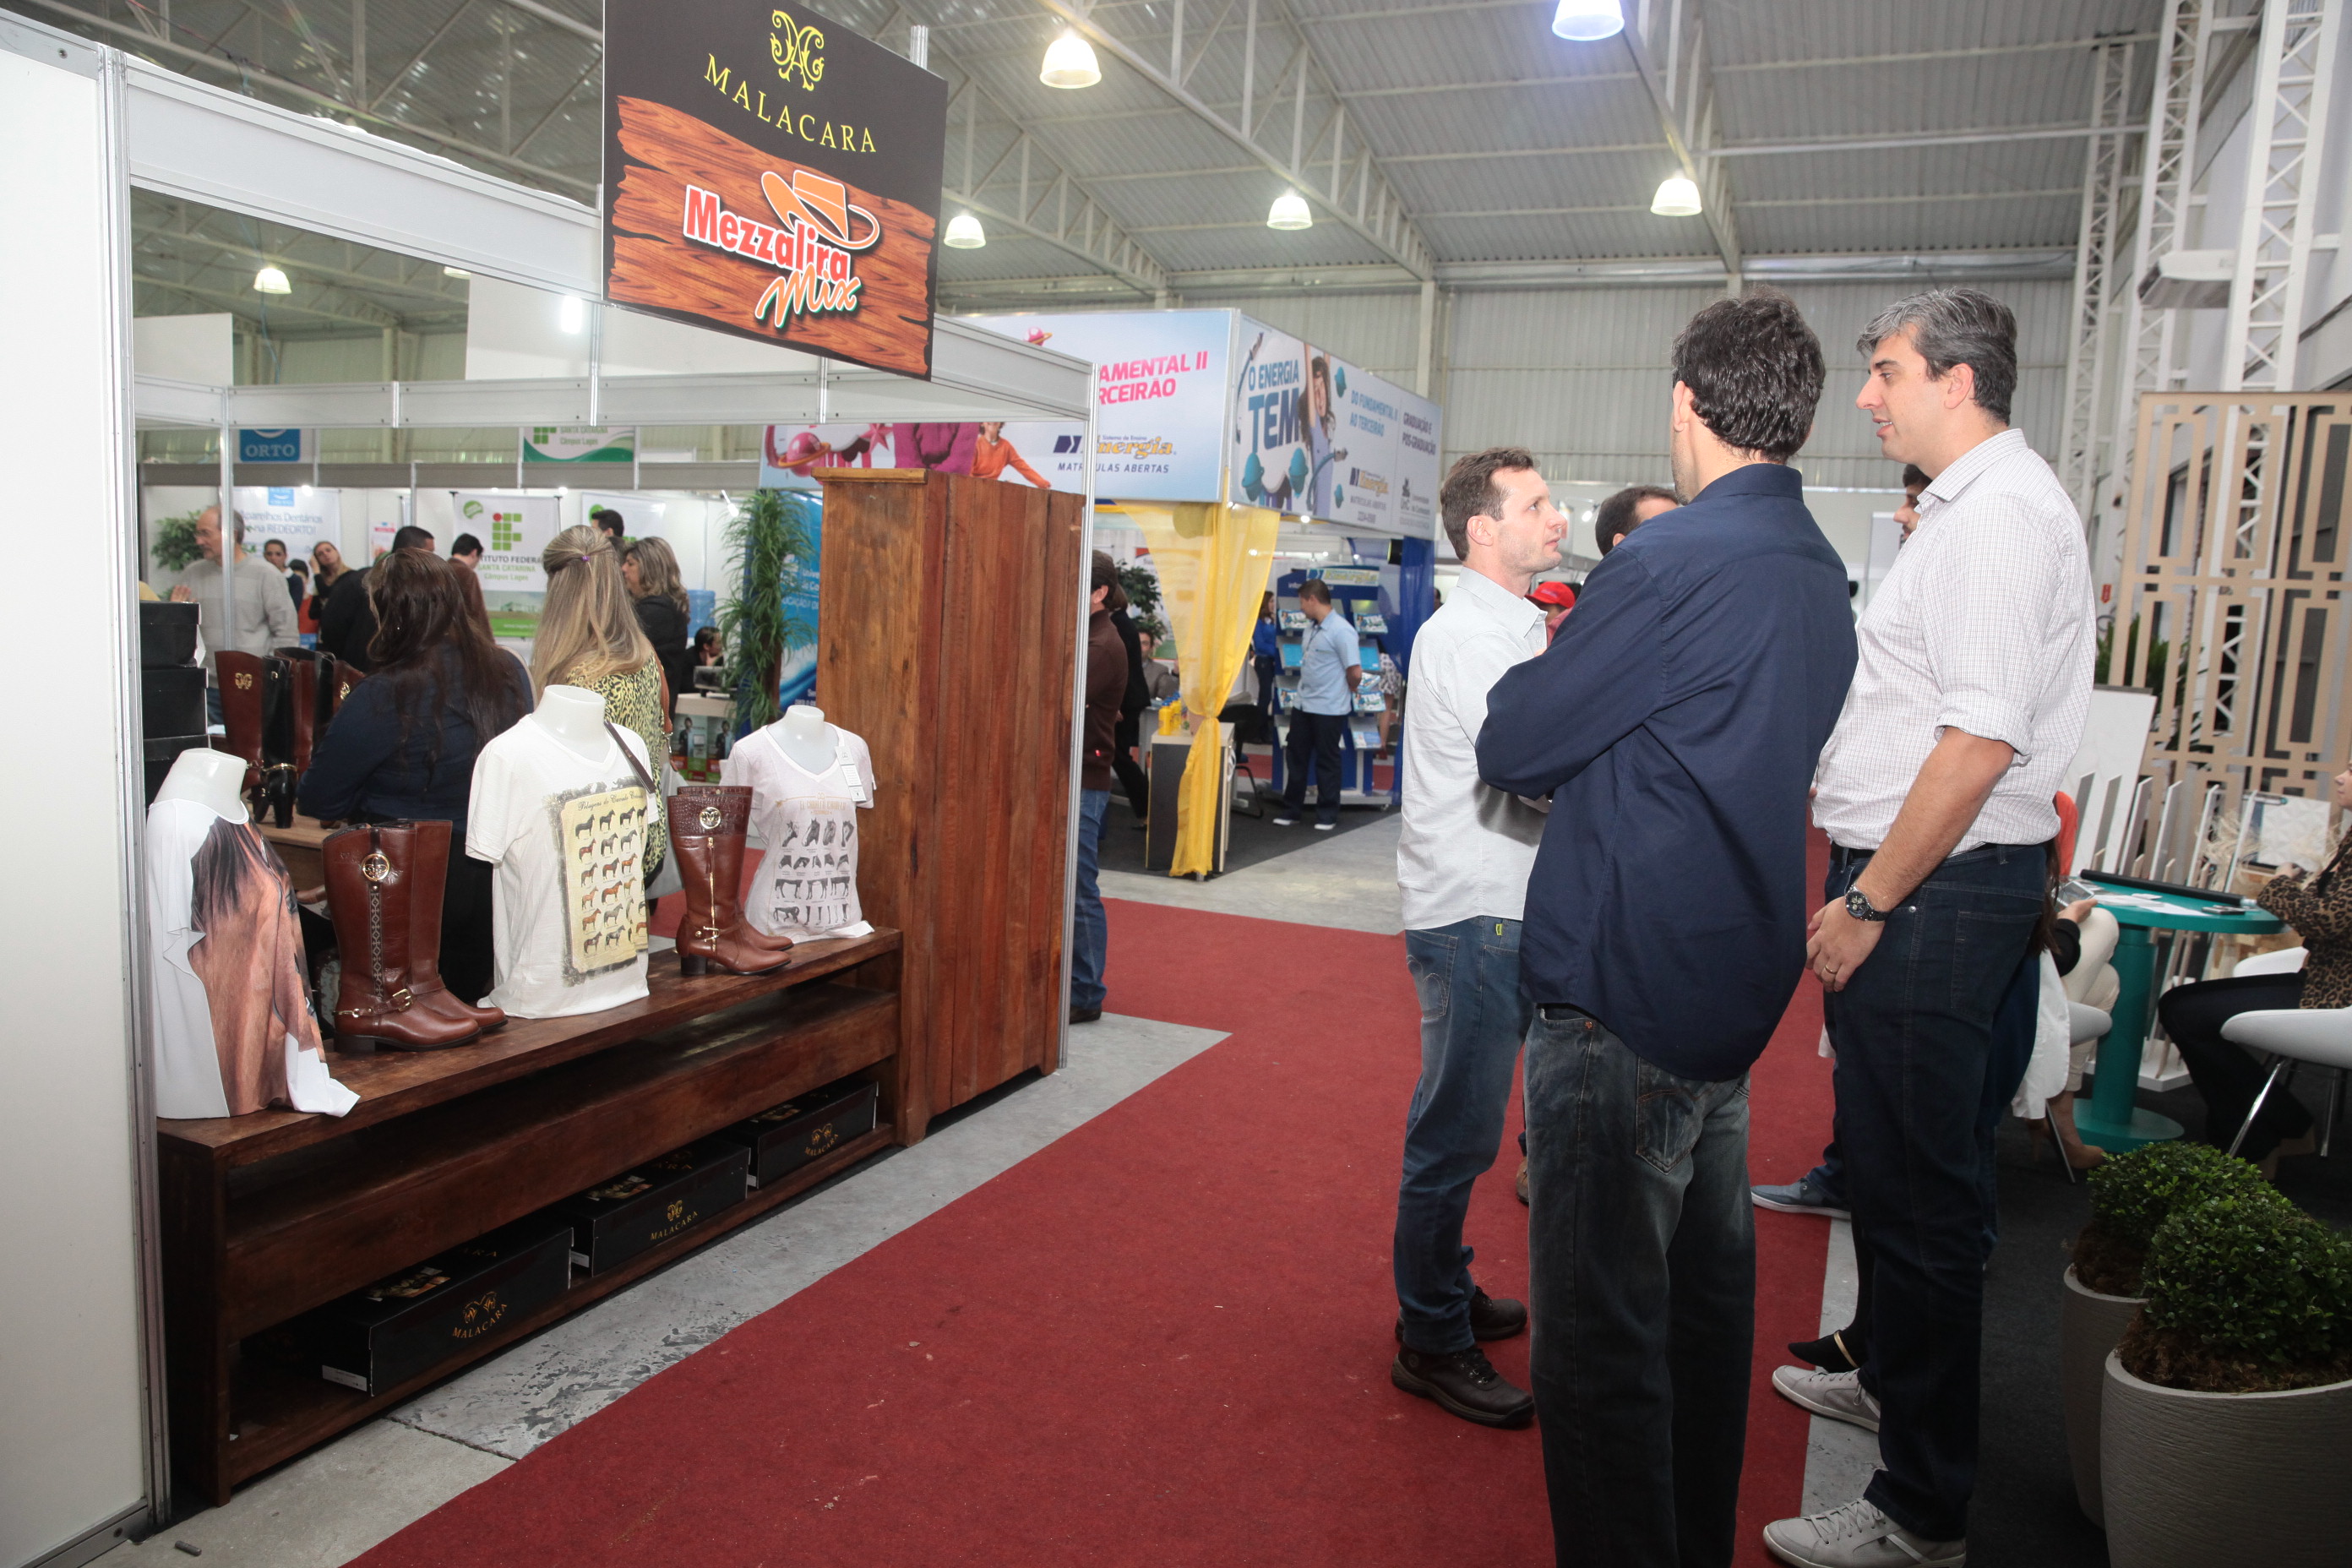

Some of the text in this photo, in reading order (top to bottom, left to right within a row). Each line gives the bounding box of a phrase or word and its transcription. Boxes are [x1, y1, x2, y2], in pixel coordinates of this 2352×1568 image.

[704, 53, 876, 153] MALACARA
[683, 183, 851, 283] Mezzalira
[754, 263, 862, 329] Mix
[1195, 351, 1208, 370] II
[1249, 359, 1299, 391] O ENERGIA
[1248, 387, 1299, 454] TEM
[244, 444, 296, 458] ORTO
[1096, 436, 1173, 460] nergia
[1124, 464, 1169, 473] ABERTAS
[651, 1211, 698, 1240] MALACARA
[453, 1304, 507, 1338] MALACARA
